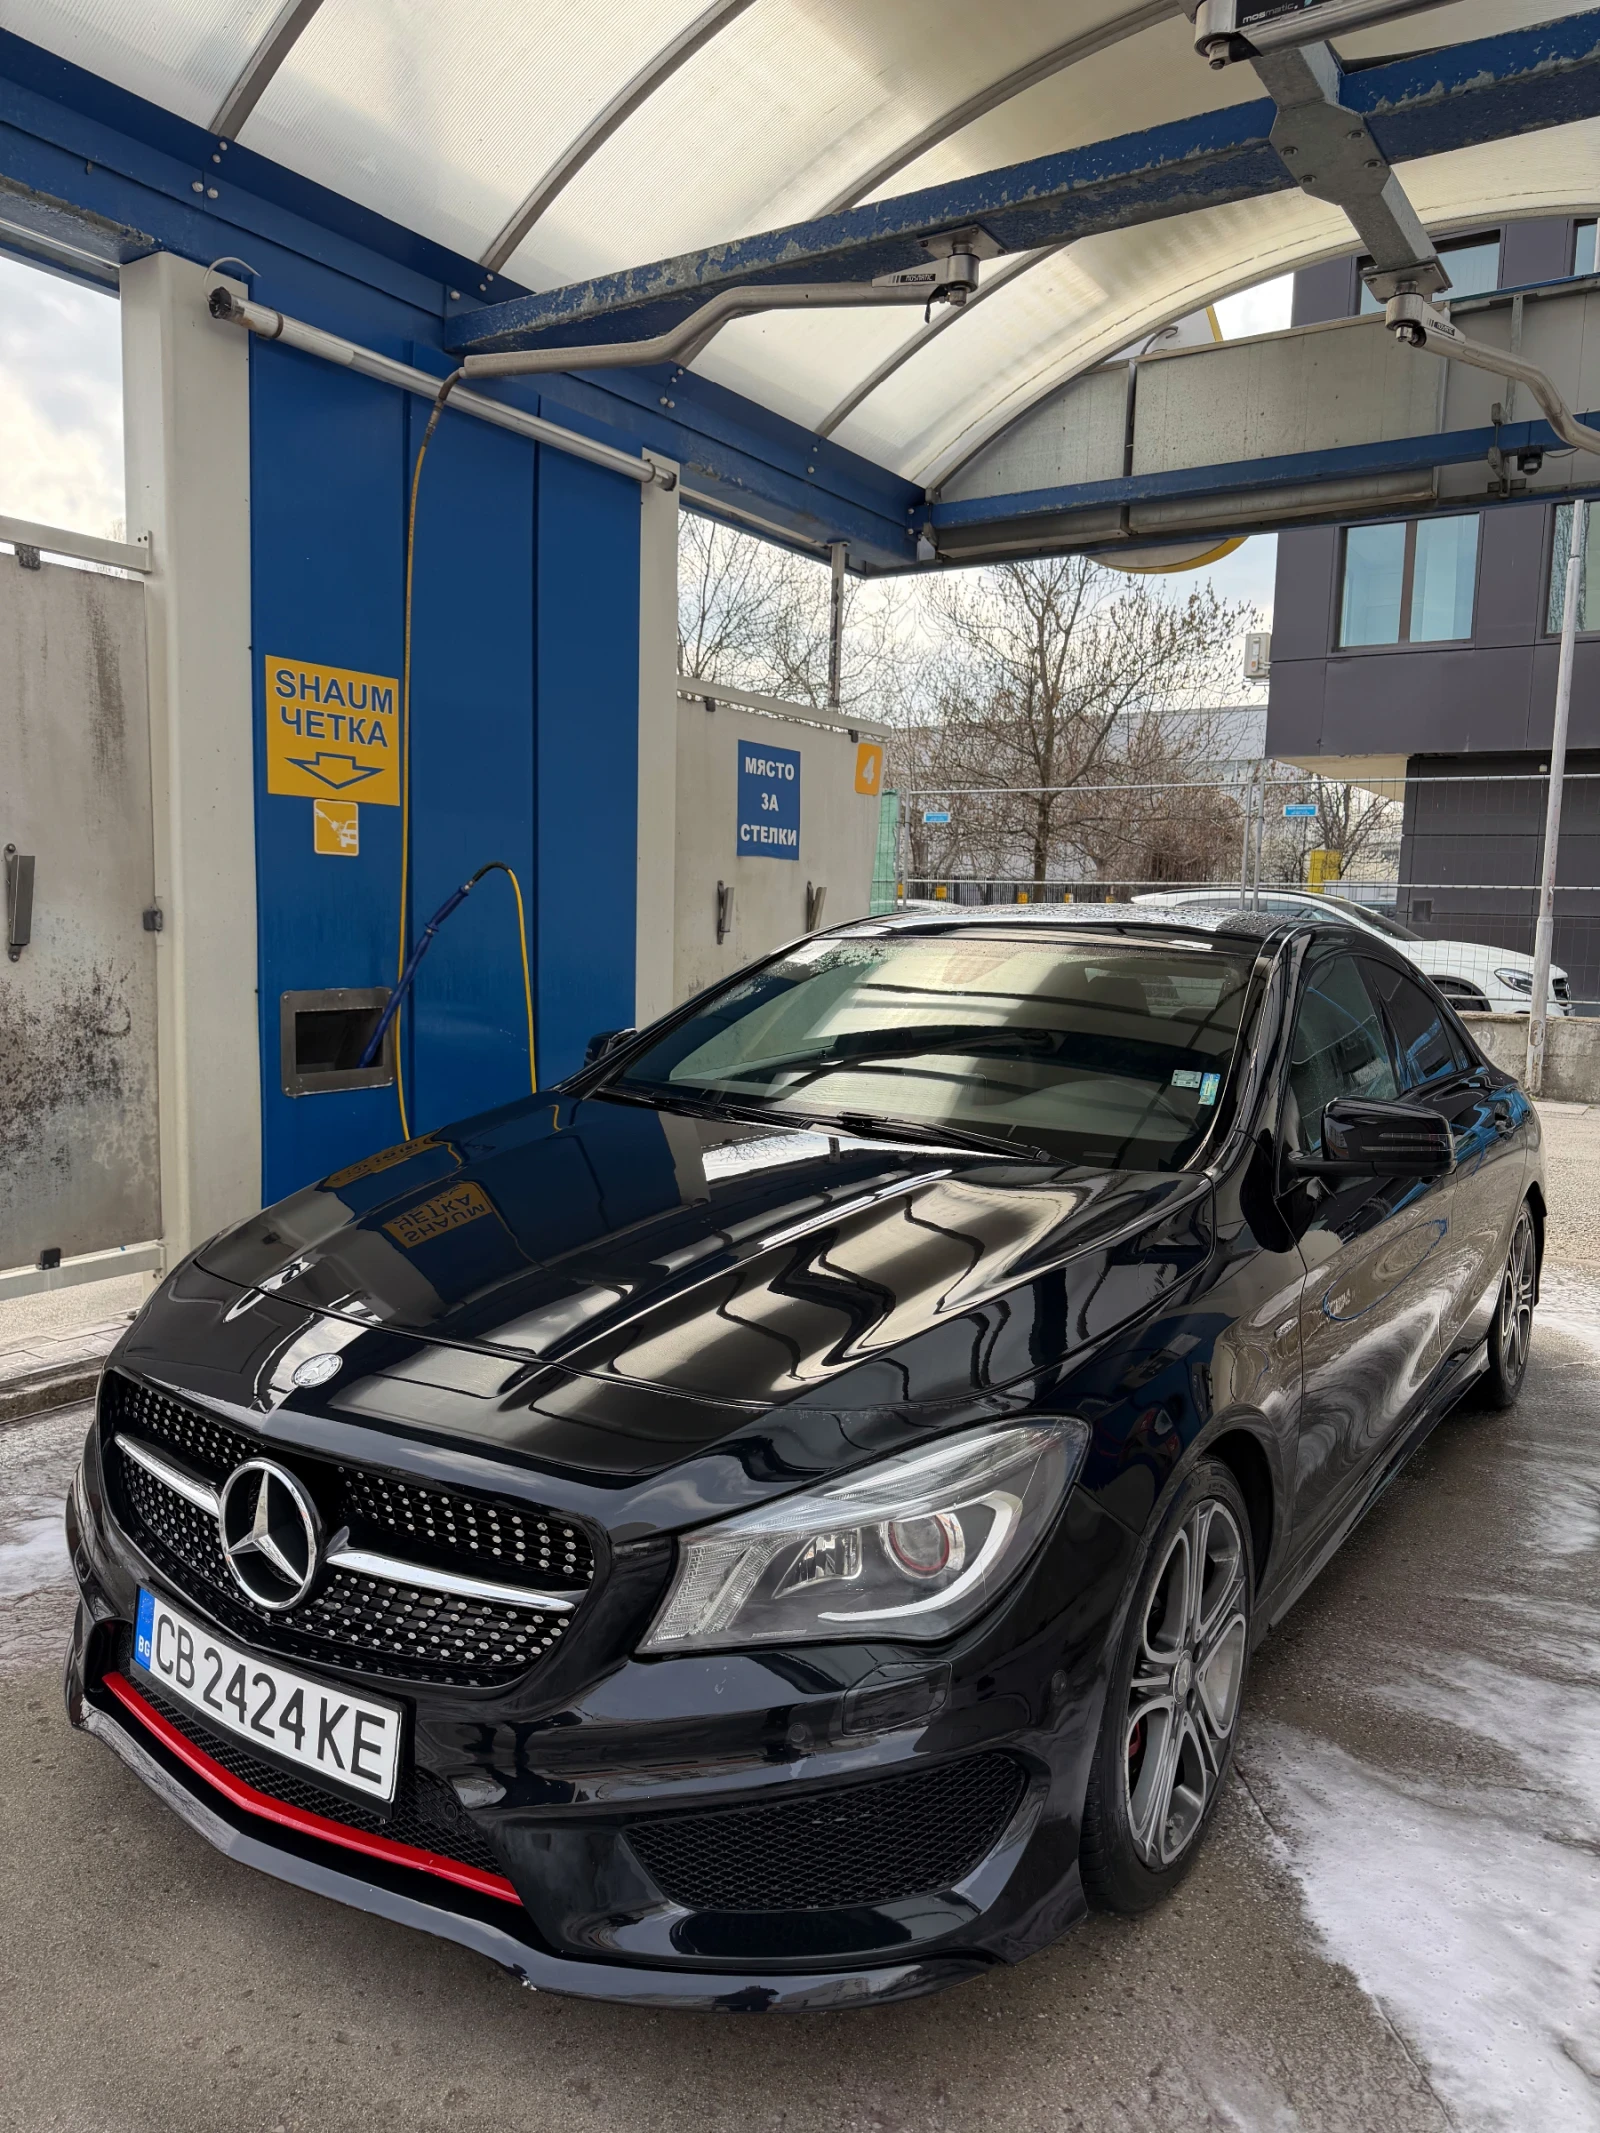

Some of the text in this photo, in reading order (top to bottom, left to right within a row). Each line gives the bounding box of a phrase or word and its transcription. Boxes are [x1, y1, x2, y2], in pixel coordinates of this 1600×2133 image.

[274, 669, 394, 715] SHAUM
[280, 705, 389, 748] ЧЕТКА
[745, 756, 795, 781] МЯСТО
[862, 755, 875, 785] 4
[761, 792, 779, 812] ЗА
[740, 823, 797, 847] СТЕЛКИ
[138, 1635, 151, 1658] BG
[203, 1647, 305, 1751] 2424
